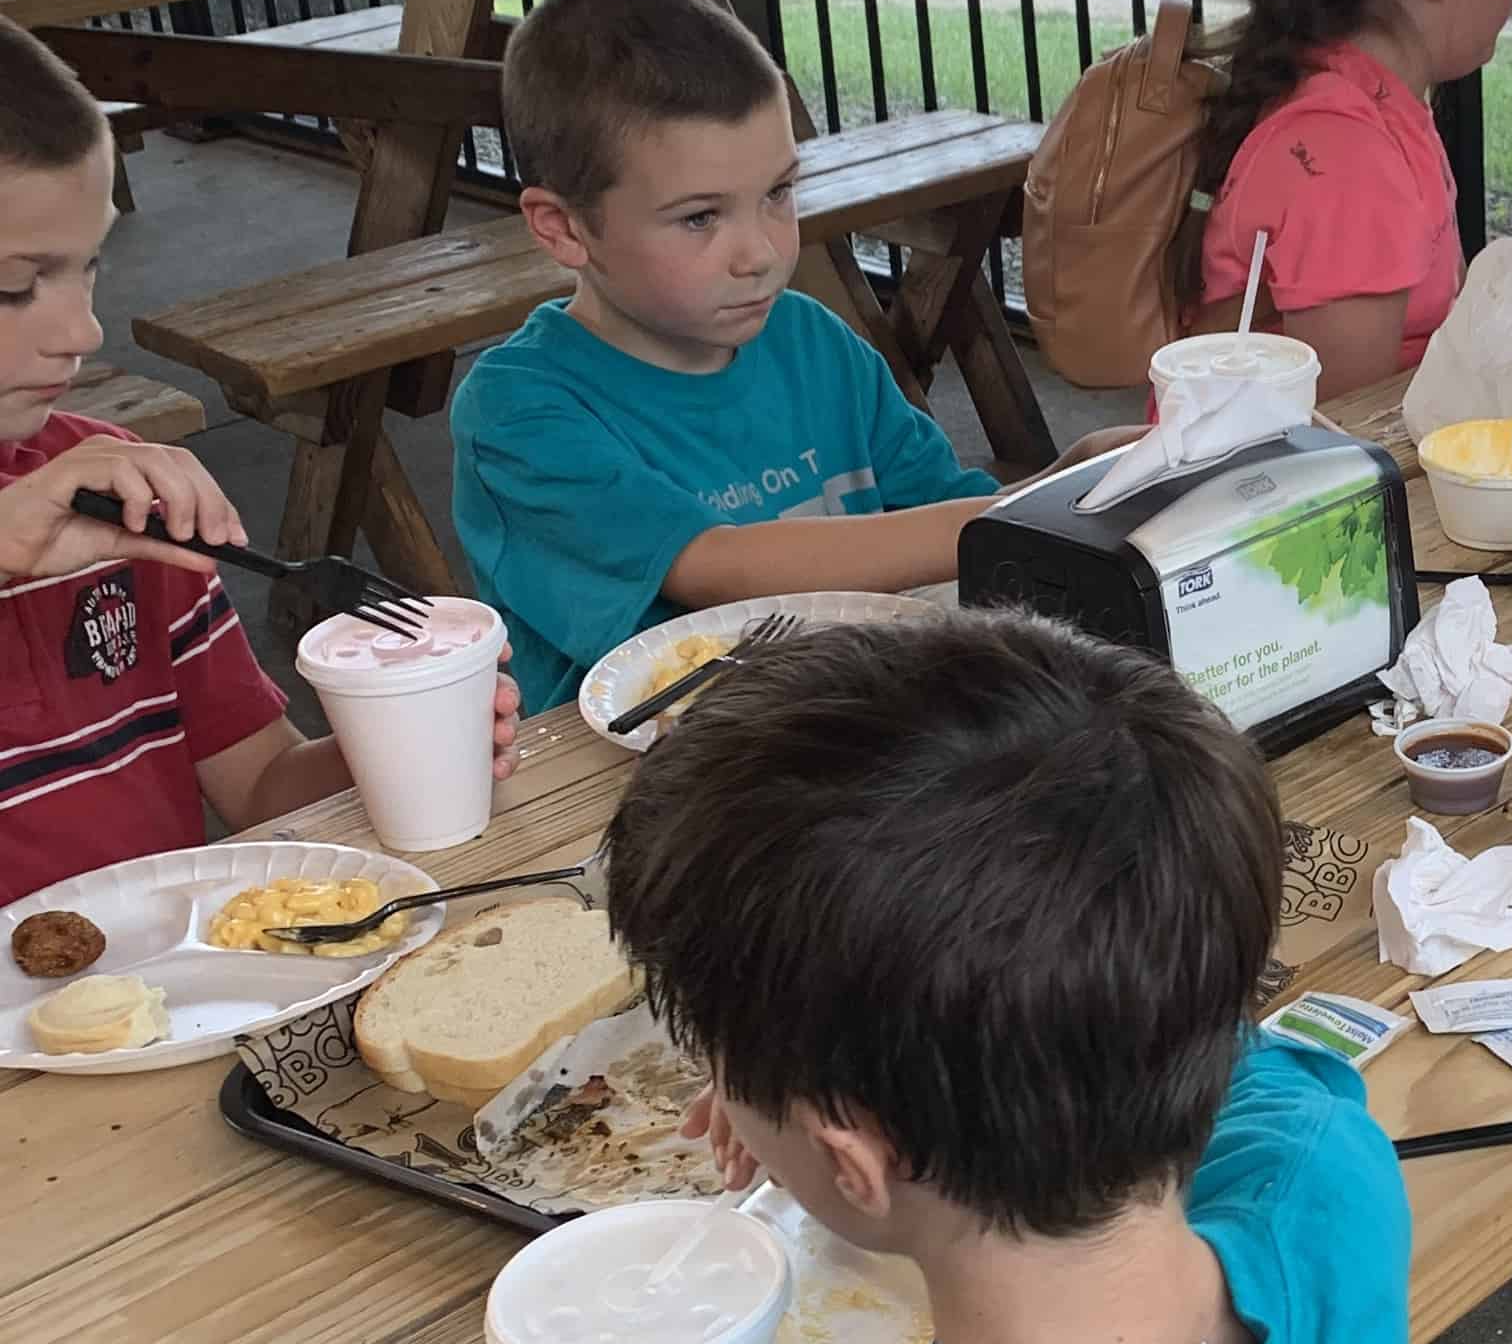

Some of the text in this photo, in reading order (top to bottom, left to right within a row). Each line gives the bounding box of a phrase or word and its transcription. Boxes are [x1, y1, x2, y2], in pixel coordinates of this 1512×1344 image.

[762, 467, 800, 494] On
[1179, 569, 1213, 597] TORK
[1233, 651, 1253, 669] for
[1255, 639, 1283, 663] you.
[1236, 668, 1255, 687] for
[1258, 659, 1279, 680] the
[1282, 640, 1323, 674] planet.
